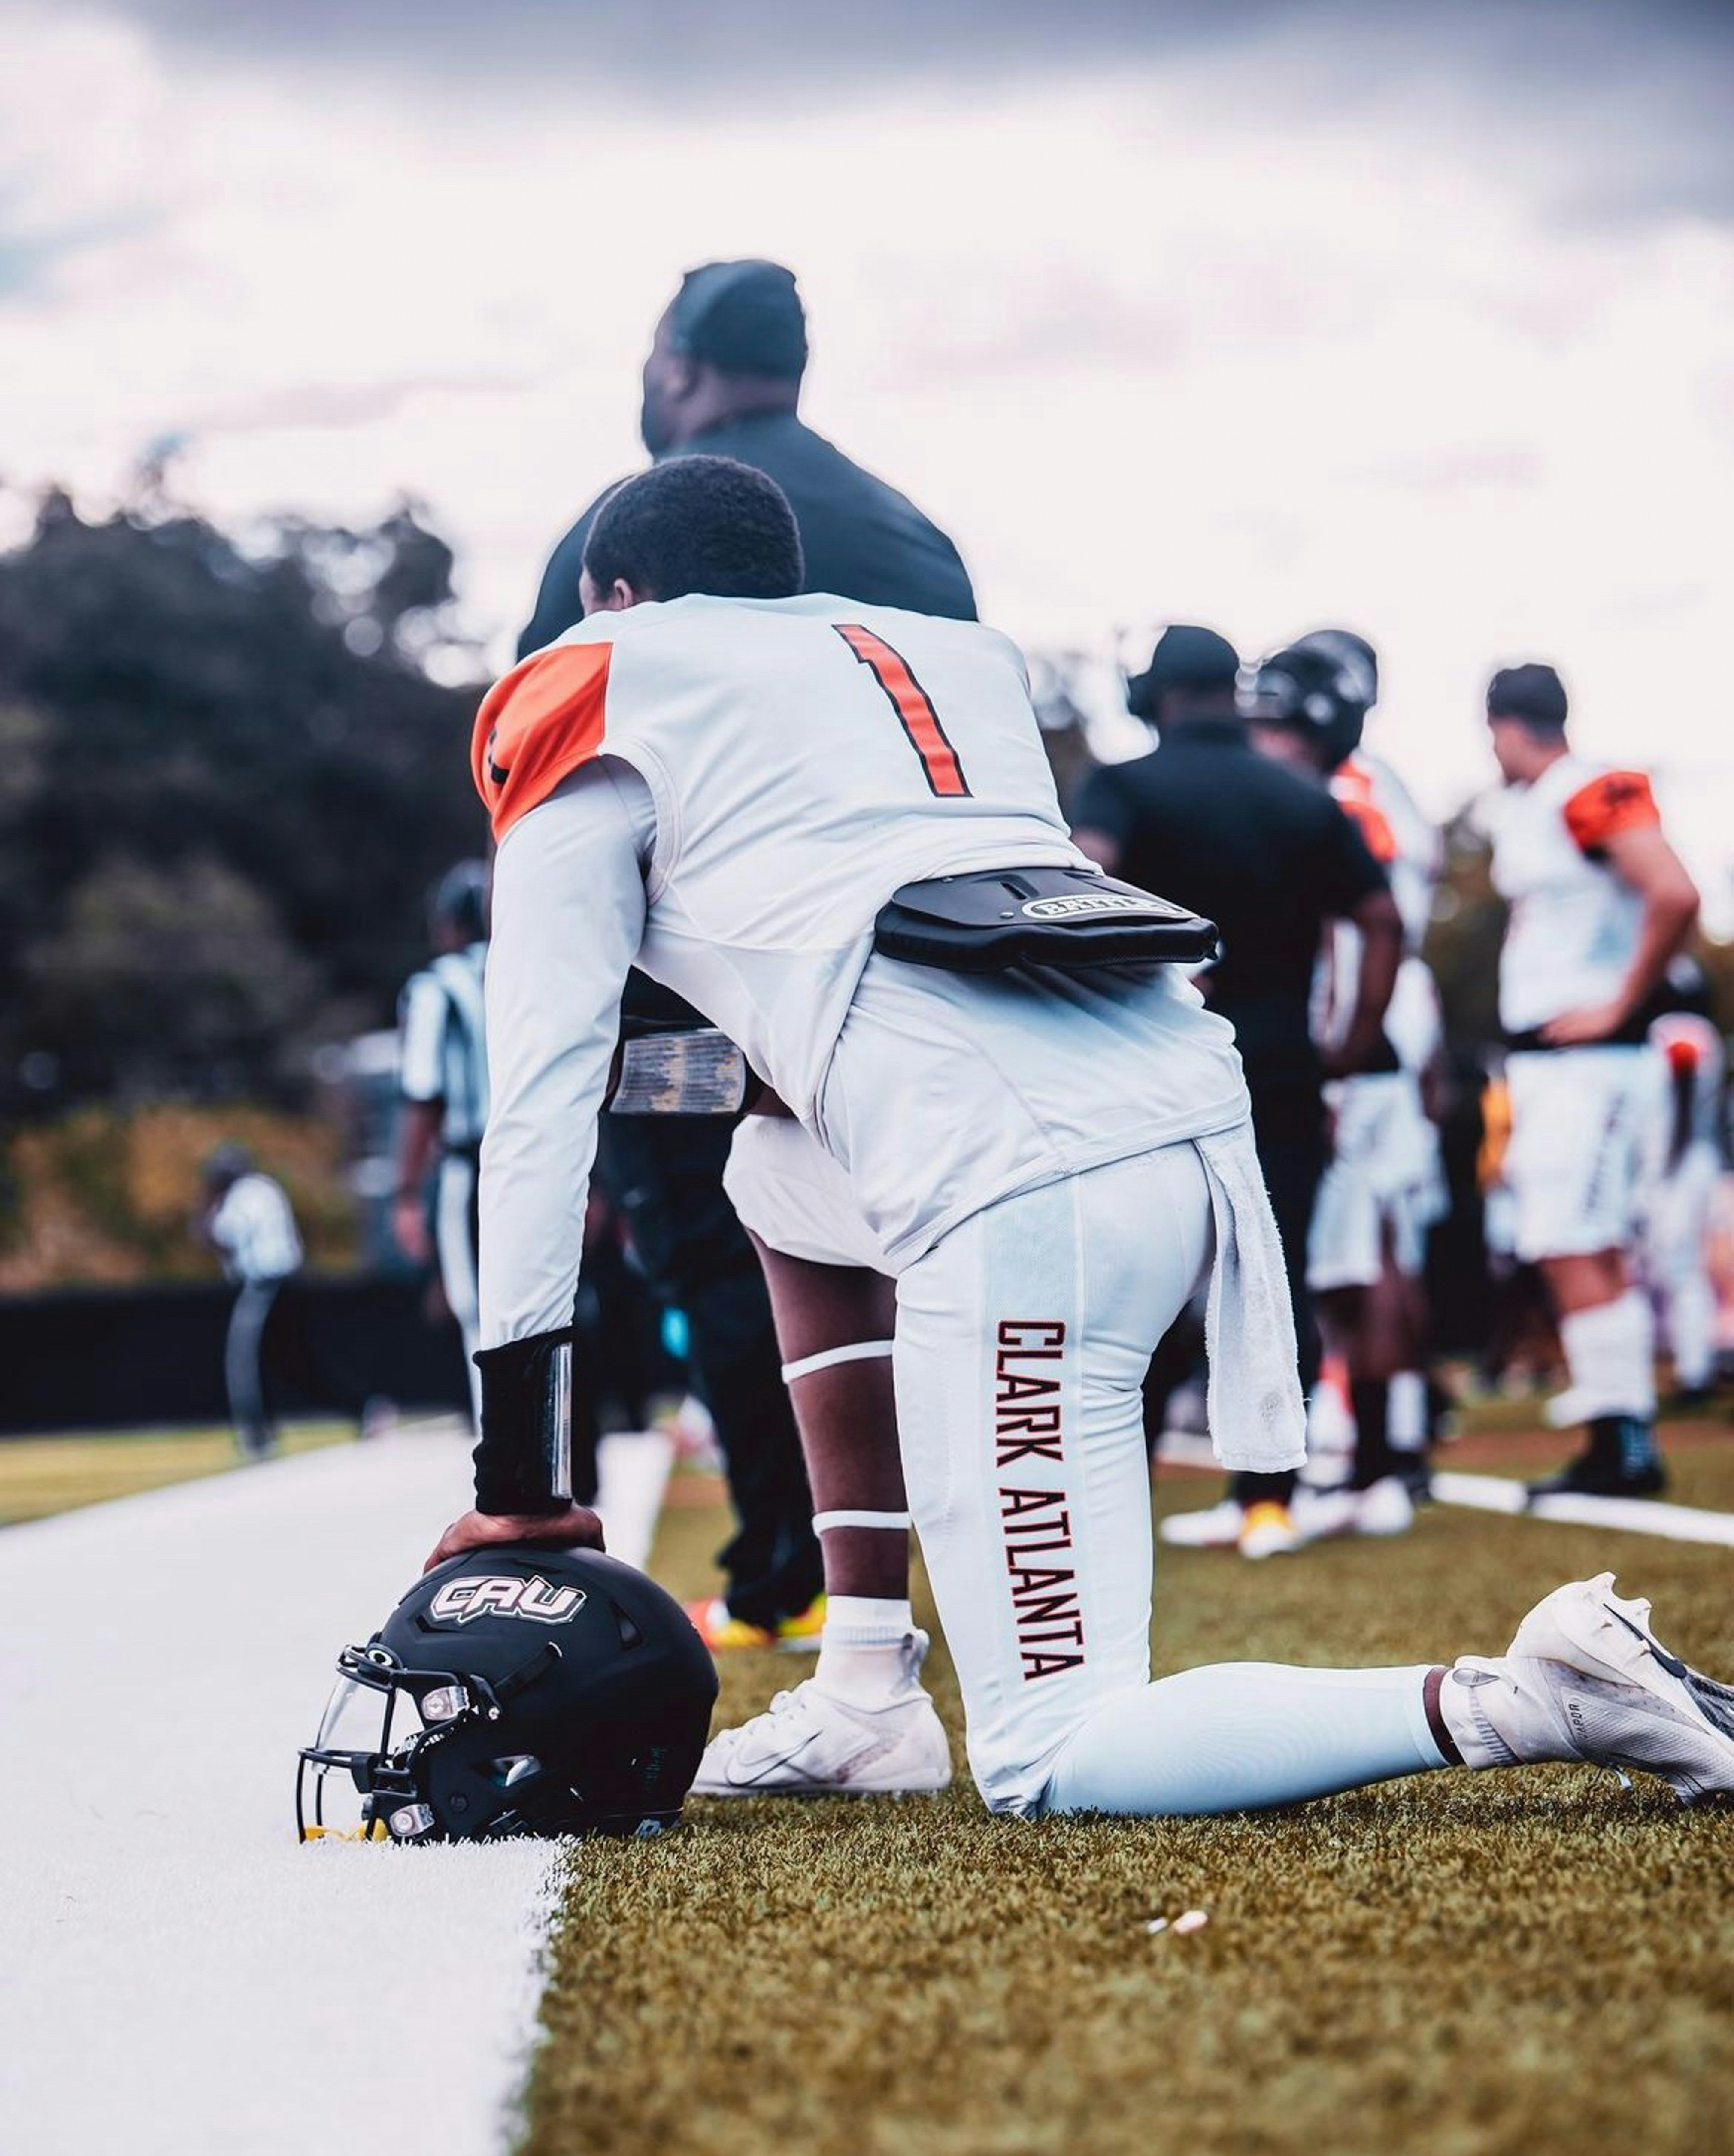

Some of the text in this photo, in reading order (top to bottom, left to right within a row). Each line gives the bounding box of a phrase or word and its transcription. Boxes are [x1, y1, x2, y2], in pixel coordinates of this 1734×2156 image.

[831, 624, 974, 798] 1
[995, 1320, 1085, 1681] CLARK ATLANTA
[430, 1575, 588, 1625] CAU
